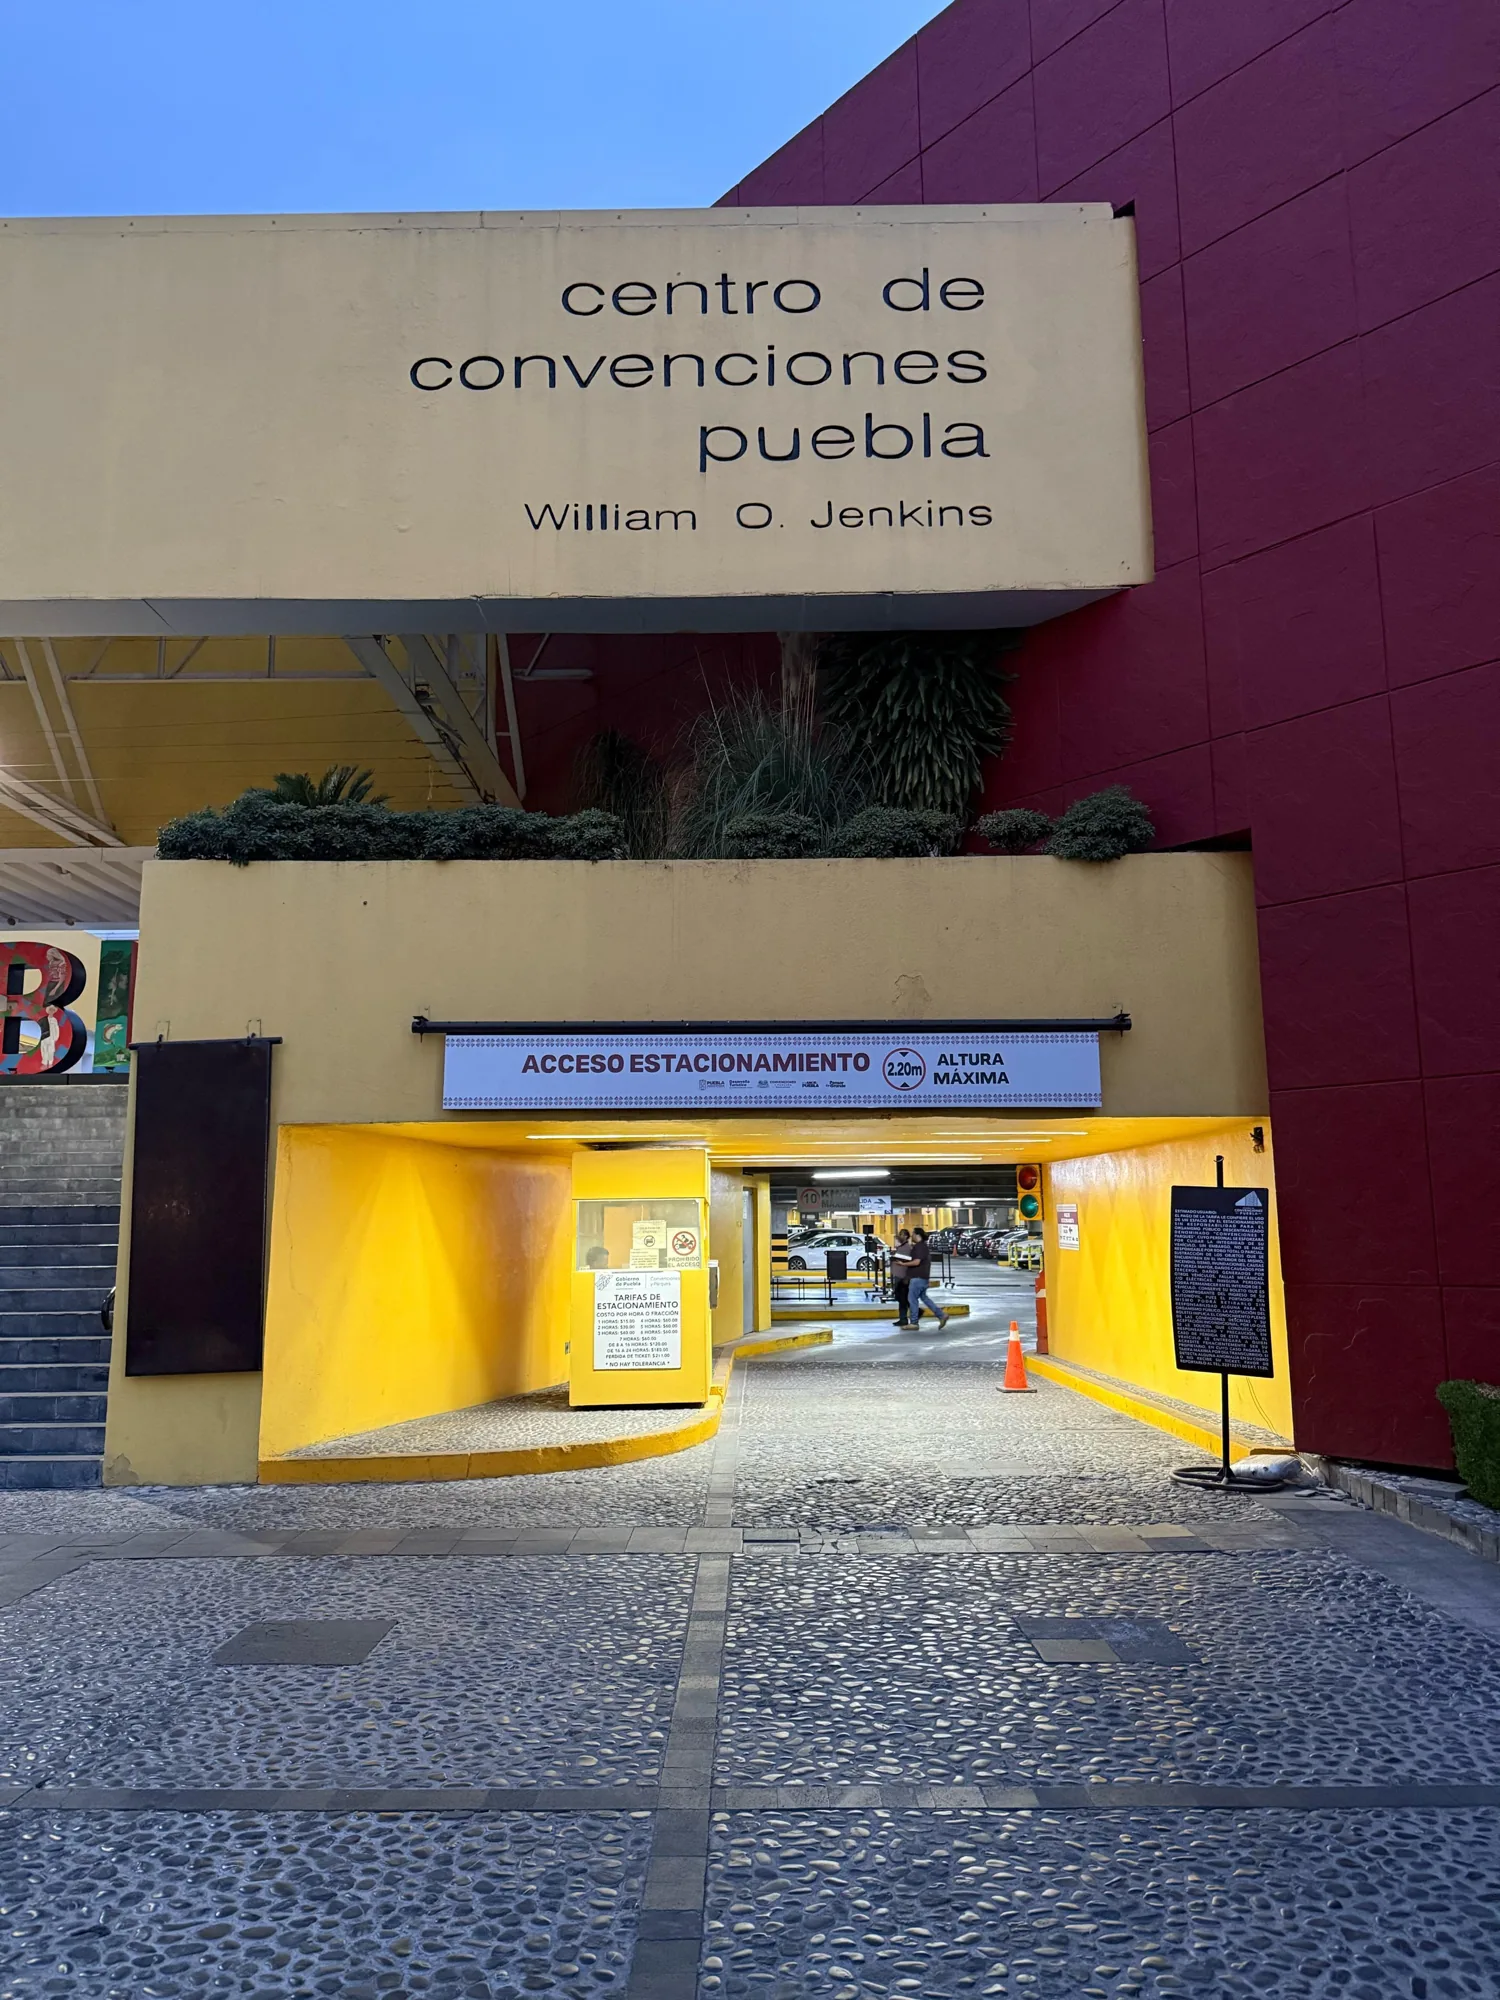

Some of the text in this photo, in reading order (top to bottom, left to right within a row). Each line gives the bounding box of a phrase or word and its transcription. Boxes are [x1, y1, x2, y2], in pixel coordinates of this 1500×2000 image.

[561, 268, 985, 316] centro de
[410, 345, 988, 390] convenciones
[700, 412, 990, 473] puebla
[524, 500, 993, 531] William O. Jenkins
[521, 1052, 870, 1074] ACCESO ESTACIONAMIENTO
[887, 1062, 922, 1076] 2.20m
[937, 1053, 1004, 1066] ALTURA
[934, 1068, 1009, 1084] MÁXIMA
[804, 1193, 816, 1204] 10
[597, 1301, 678, 1310] ESTACIONAMIENTO
